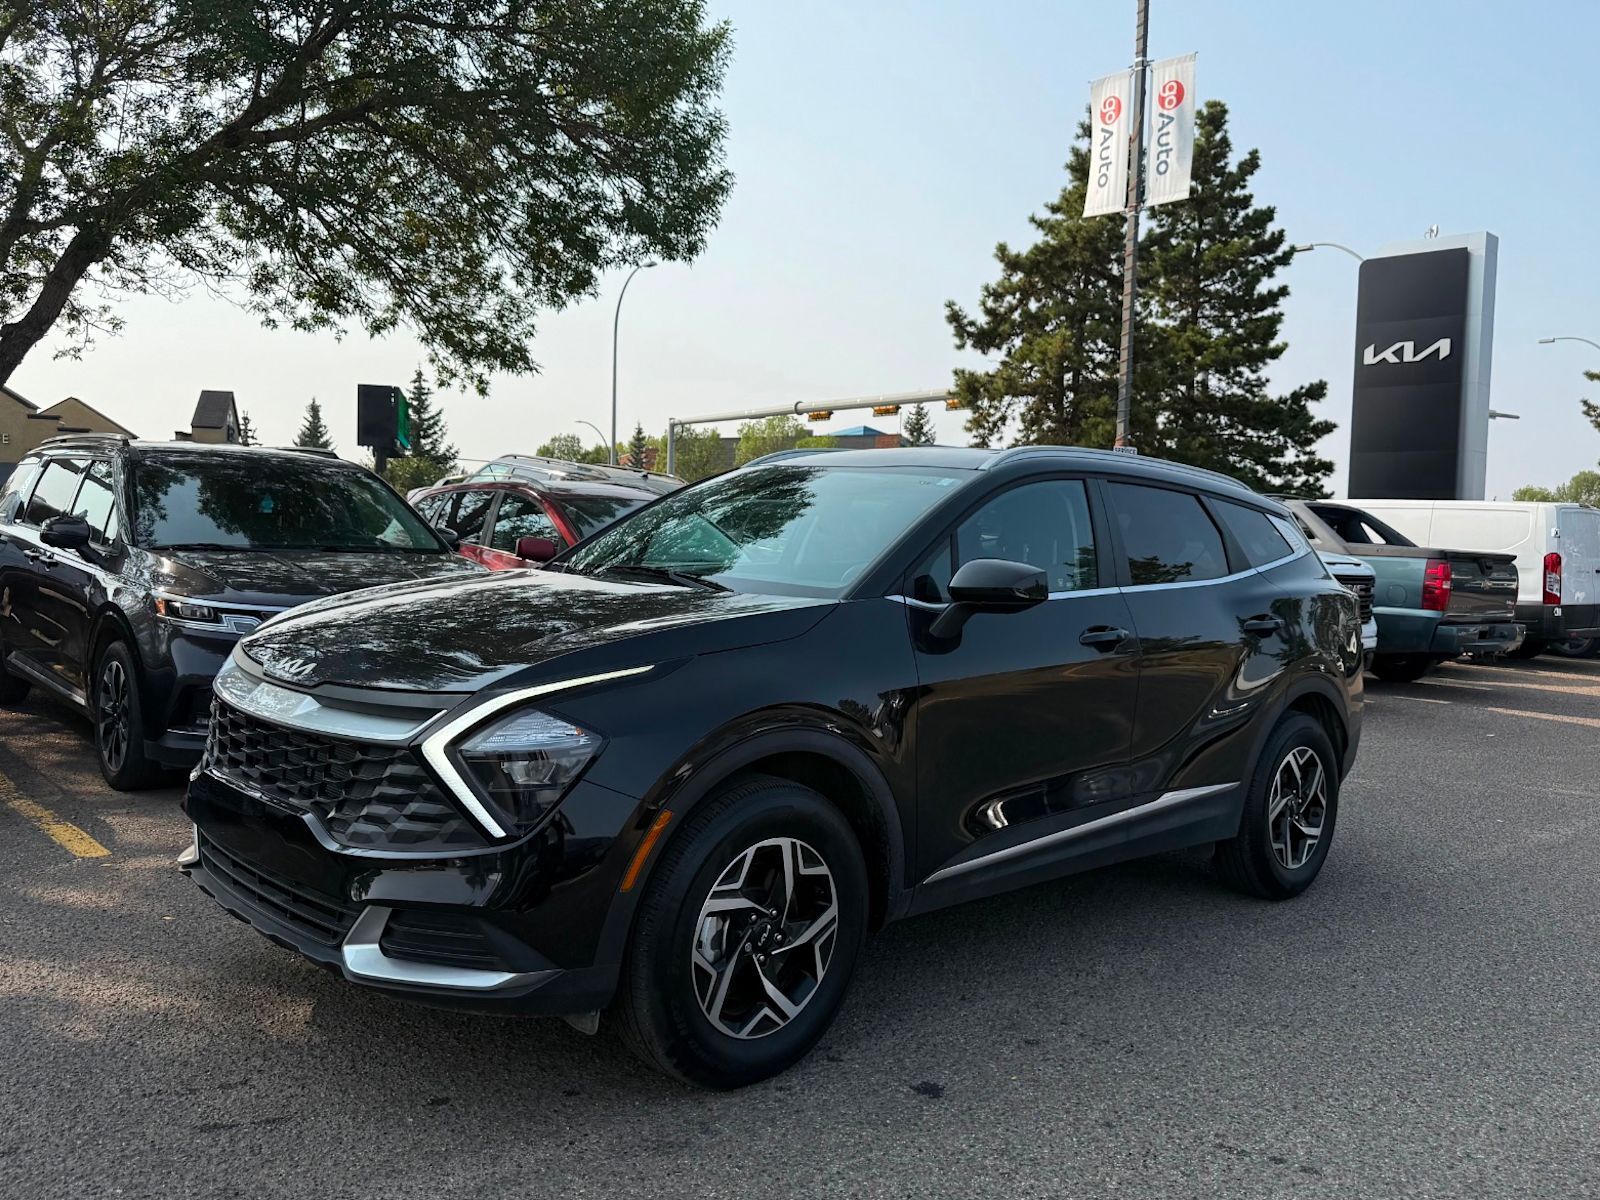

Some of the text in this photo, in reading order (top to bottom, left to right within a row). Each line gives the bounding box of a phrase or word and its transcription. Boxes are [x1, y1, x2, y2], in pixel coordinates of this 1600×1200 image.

[1097, 127, 1114, 188] Auto
[1156, 112, 1175, 176] Auto
[1363, 338, 1451, 365] KIA
[276, 657, 317, 676] KIA
